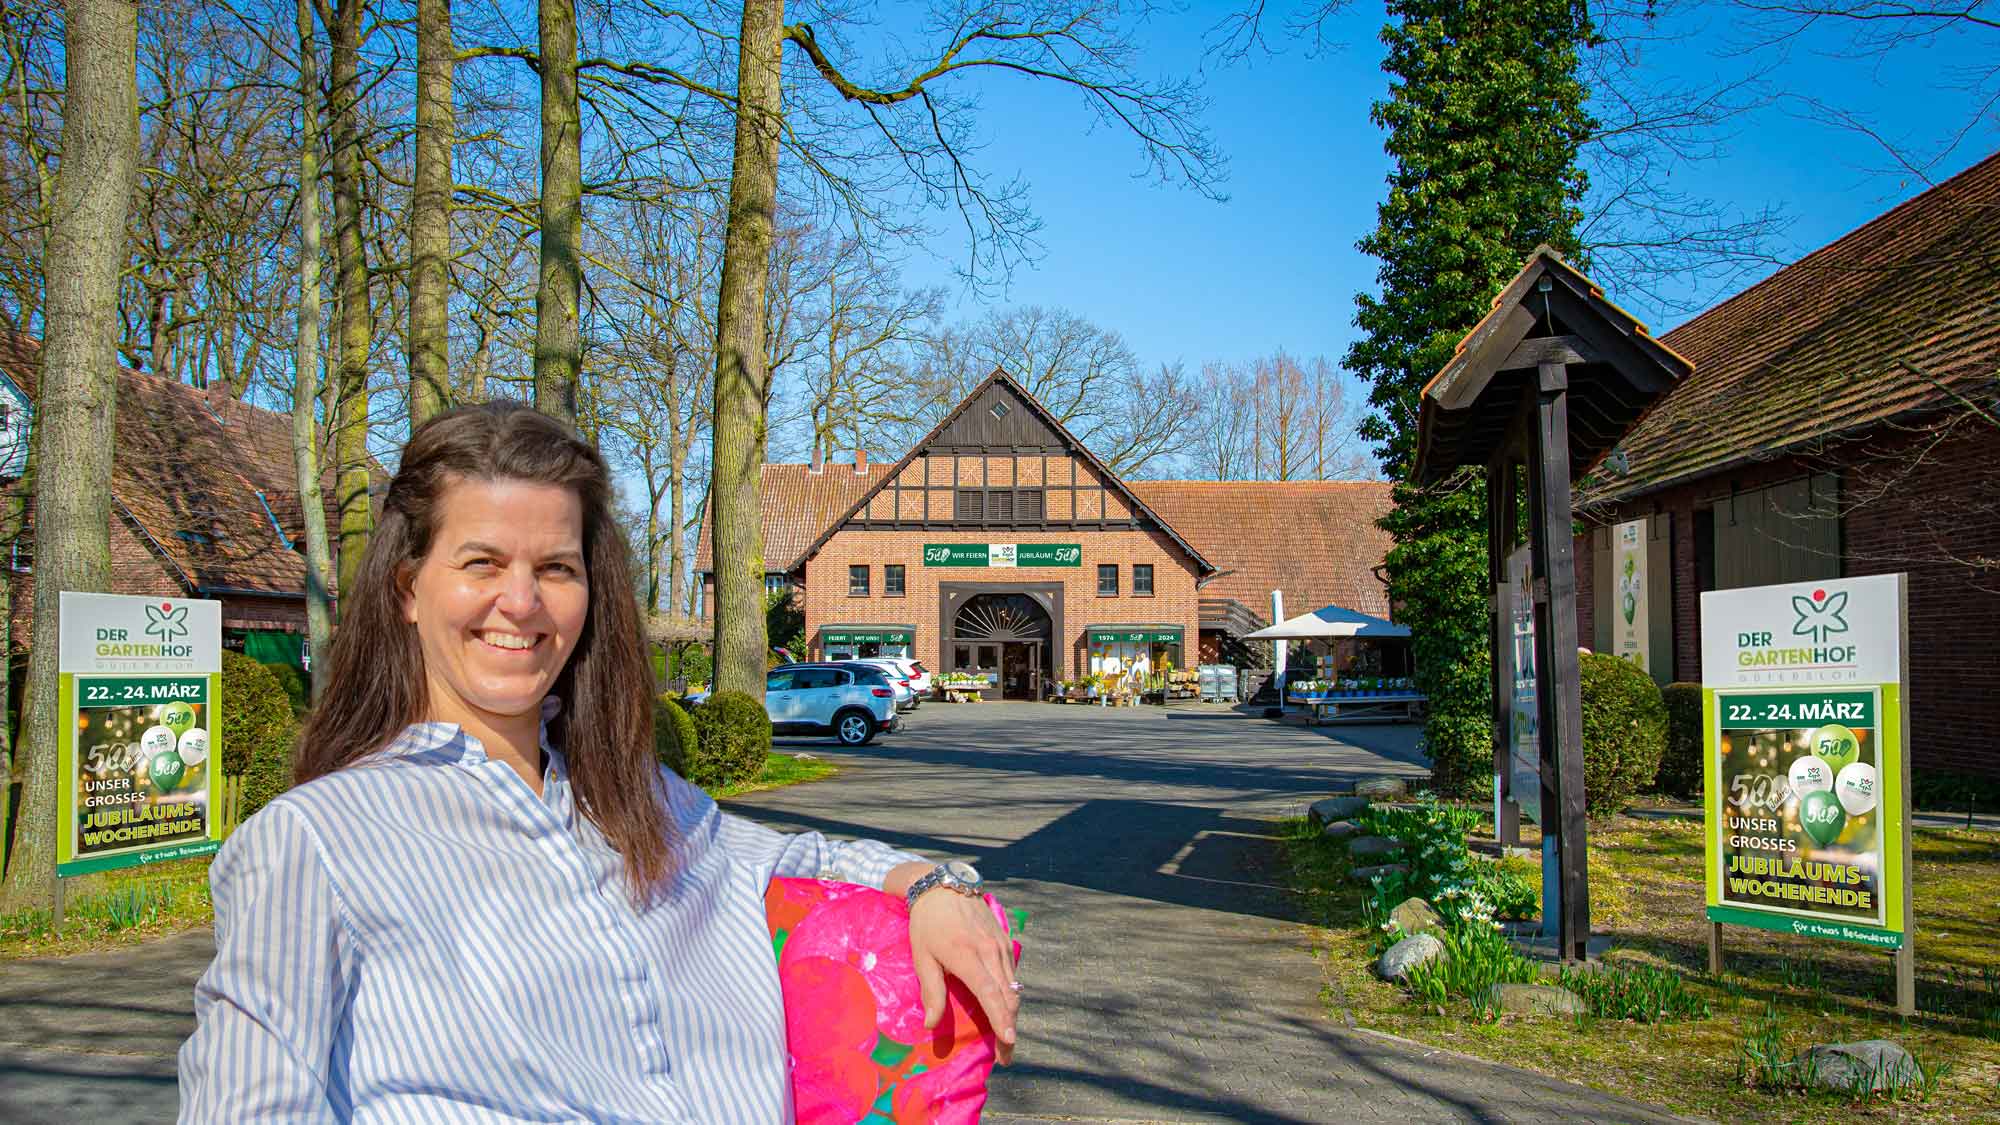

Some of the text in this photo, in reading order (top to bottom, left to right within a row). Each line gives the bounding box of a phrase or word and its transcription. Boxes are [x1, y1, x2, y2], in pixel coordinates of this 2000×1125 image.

[96, 628, 128, 641] DER
[1738, 631, 1773, 648] DER
[96, 643, 193, 657] GARTENHOF
[1738, 645, 1857, 667] GARTENHOF
[151, 682, 201, 699] MÄRZ
[1799, 699, 1865, 720] MÄRZ
[85, 778, 130, 792] UNSER
[85, 791, 146, 807] GROSSES
[84, 800, 201, 829] JUBILÄUMS-
[84, 818, 201, 846] WOCHENENDE
[1729, 817, 1777, 832] UNSER
[1729, 835, 1797, 852] GROSSES
[1729, 855, 1871, 885] JUBILÄUMS-
[1729, 877, 1872, 909] WOCHENENDE
[1792, 920, 1808, 934] für
[1810, 924, 1840, 936] etwas
